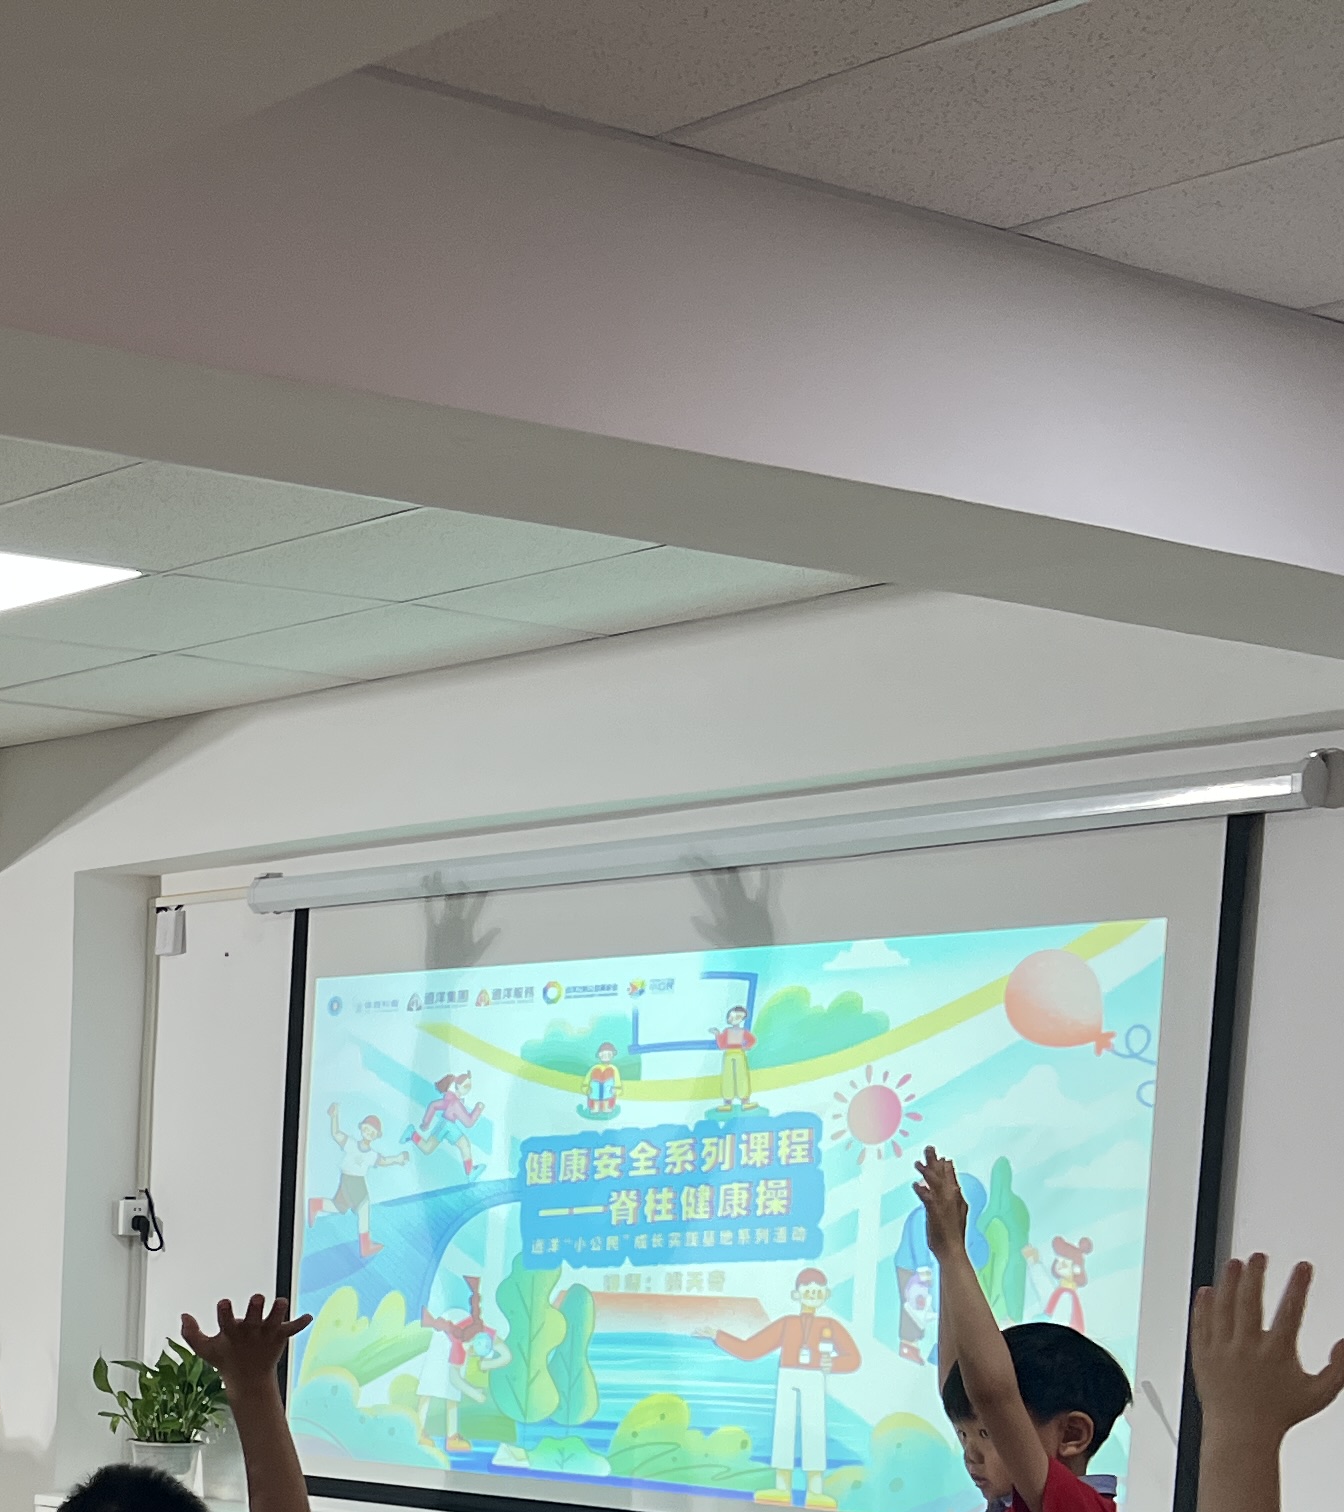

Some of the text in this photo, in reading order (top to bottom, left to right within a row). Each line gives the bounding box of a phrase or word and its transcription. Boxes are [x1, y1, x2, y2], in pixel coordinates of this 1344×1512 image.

[525, 1127, 814, 1187] 健康安全系列课程
